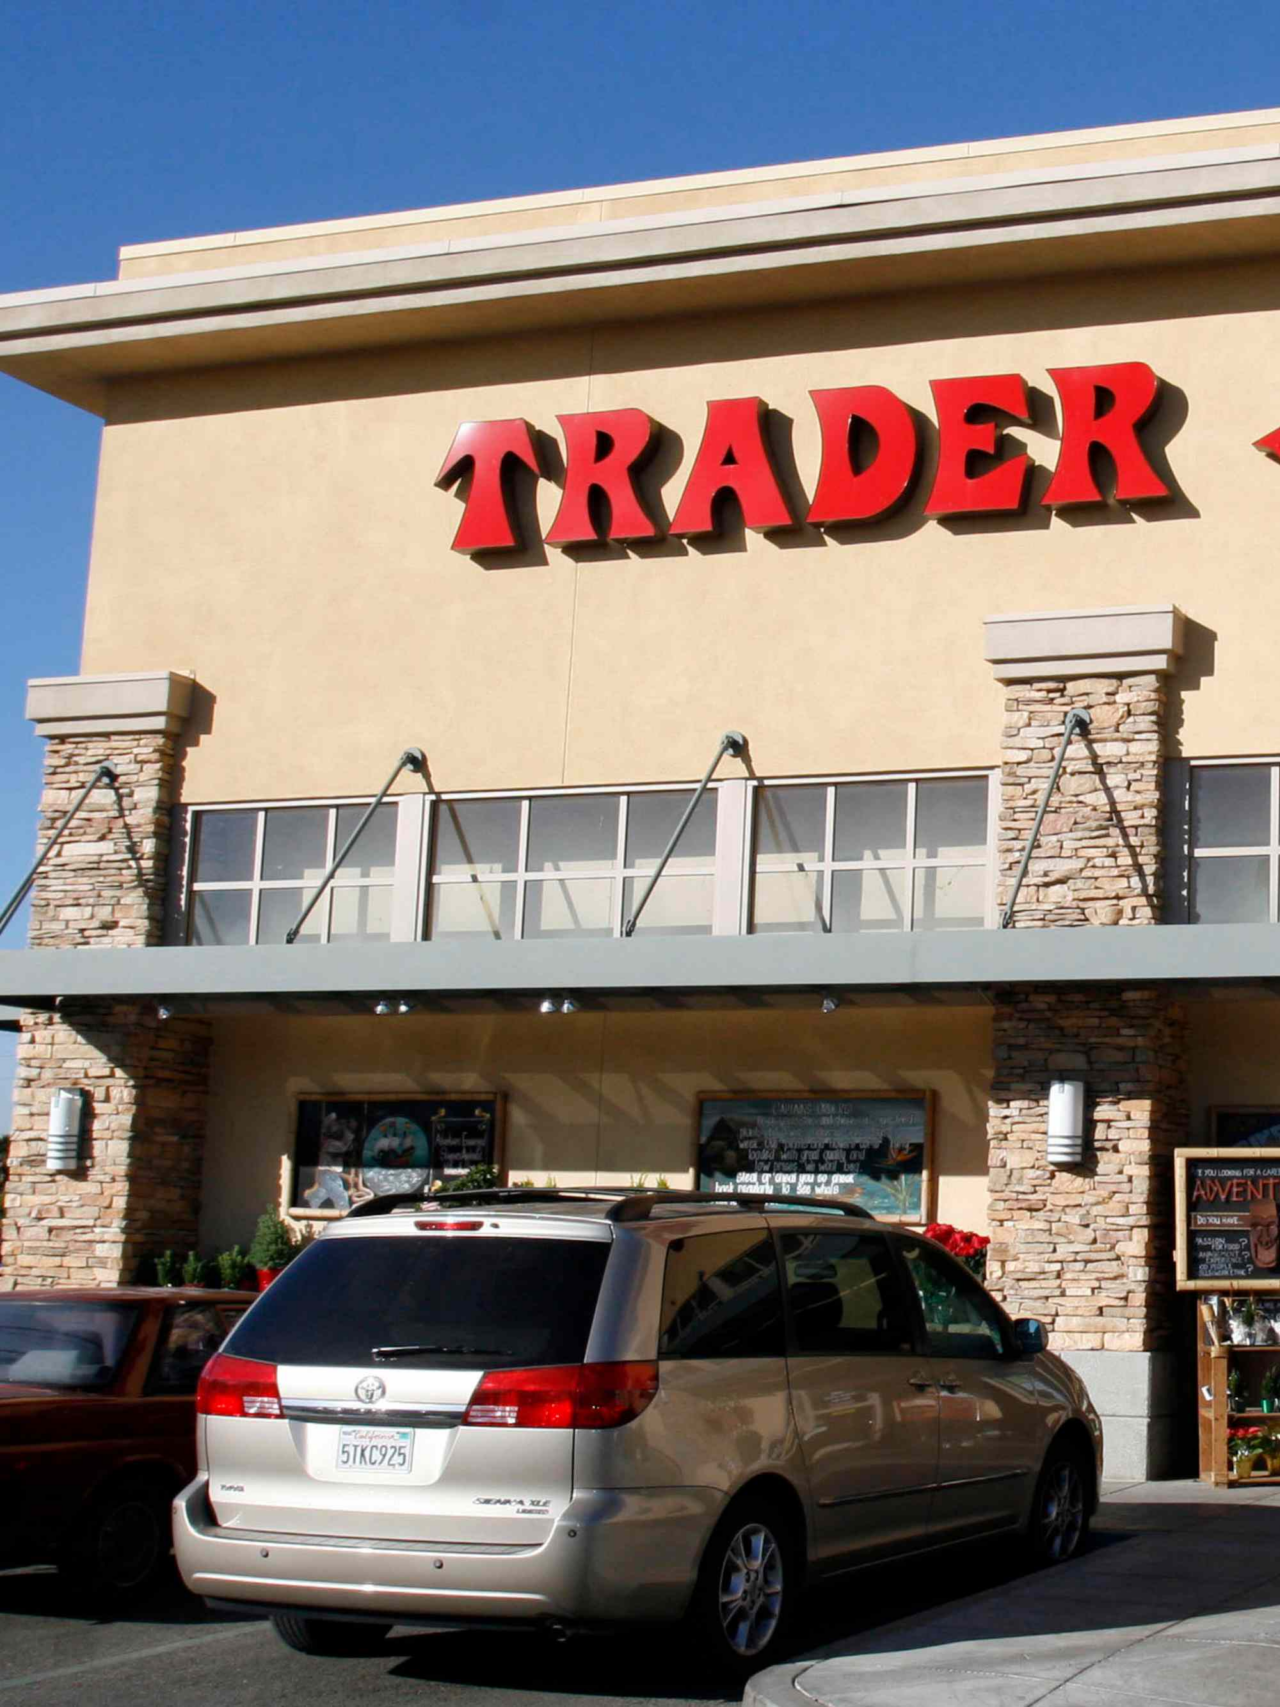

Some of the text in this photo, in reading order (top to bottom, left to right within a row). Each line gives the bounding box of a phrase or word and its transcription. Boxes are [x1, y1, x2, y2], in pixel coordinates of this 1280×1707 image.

[434, 361, 1169, 553] TRADER
[1204, 1168, 1216, 1176] YOU
[1218, 1168, 1242, 1177] LOOKING
[1243, 1168, 1255, 1176] FOR
[1256, 1168, 1262, 1176] A
[798, 1173, 815, 1185] you
[1197, 1215, 1208, 1224] DO
[1208, 1215, 1221, 1225] YOU
[354, 1430, 394, 1442] California
[341, 1444, 407, 1467] 5TKC925
